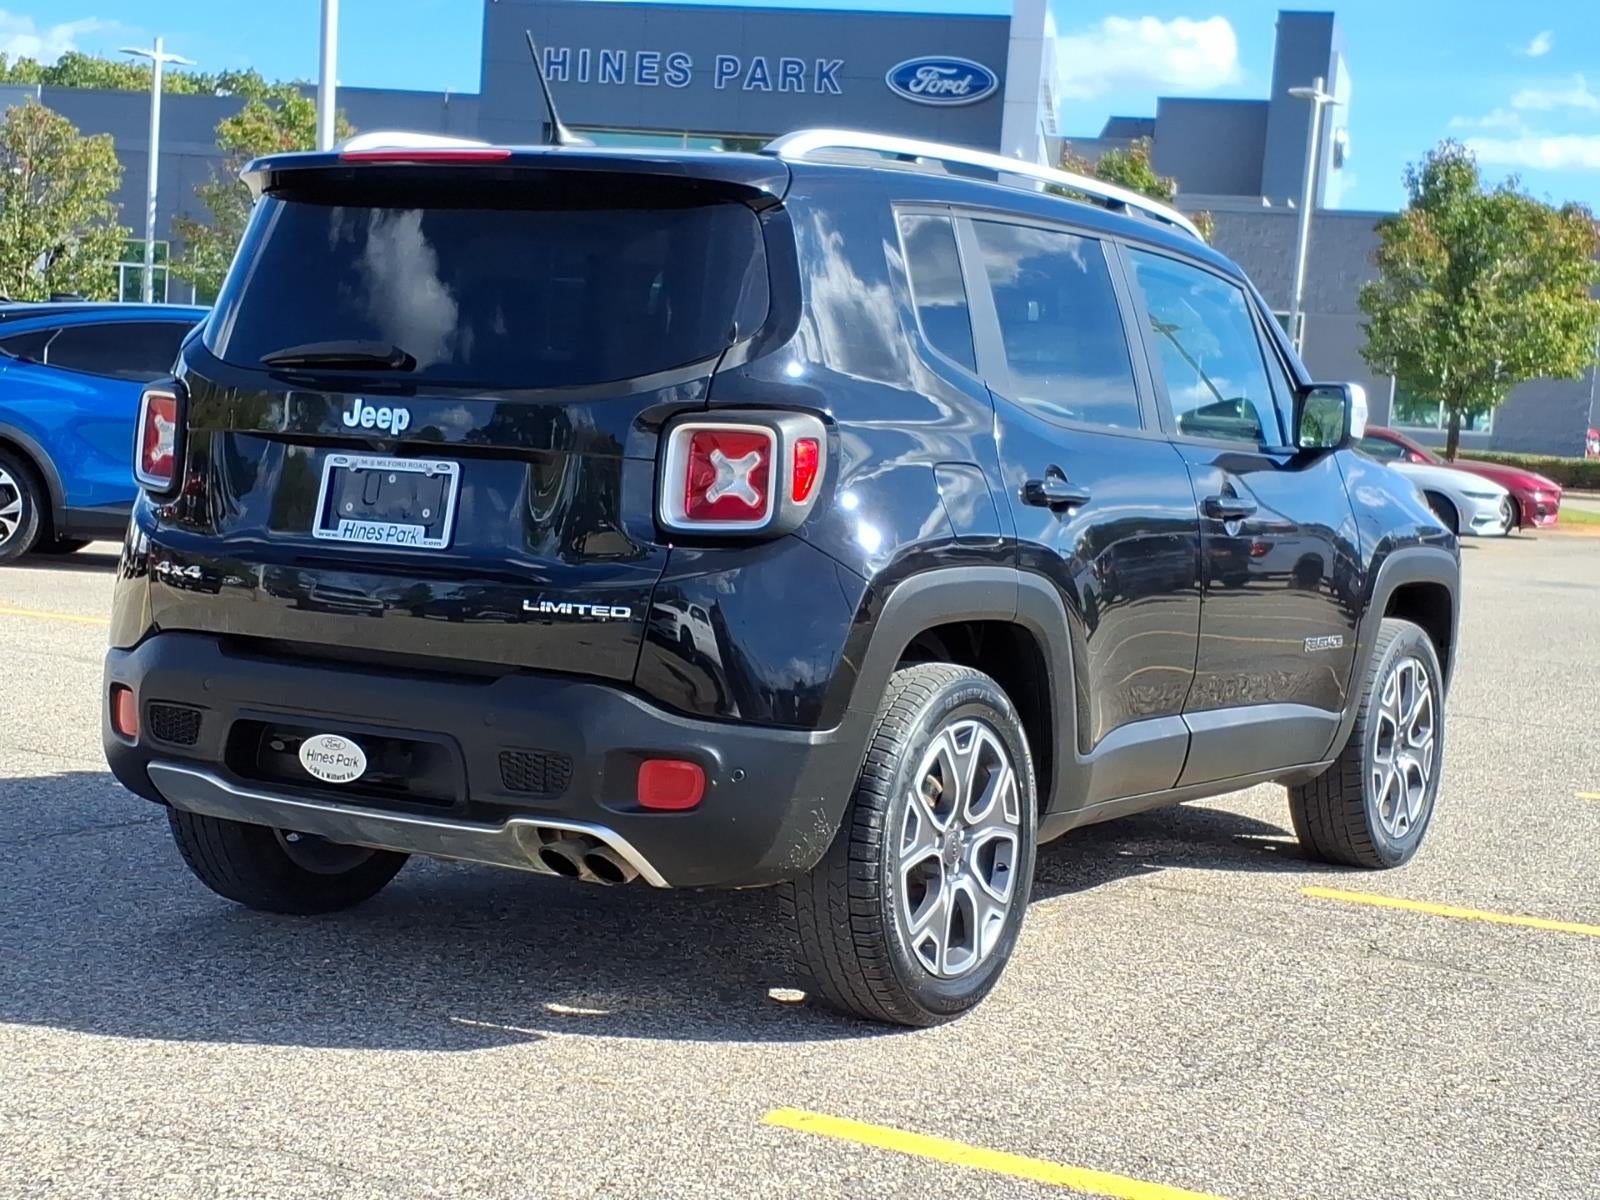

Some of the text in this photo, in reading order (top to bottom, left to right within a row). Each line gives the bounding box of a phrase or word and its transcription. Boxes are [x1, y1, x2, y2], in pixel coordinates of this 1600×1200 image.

[543, 47, 844, 94] HINES PARK
[908, 66, 974, 95] Ford
[342, 398, 410, 435] Jeep
[155, 561, 202, 579] 4x4
[522, 599, 632, 619] LIMITED
[306, 749, 359, 768] Hines Park
